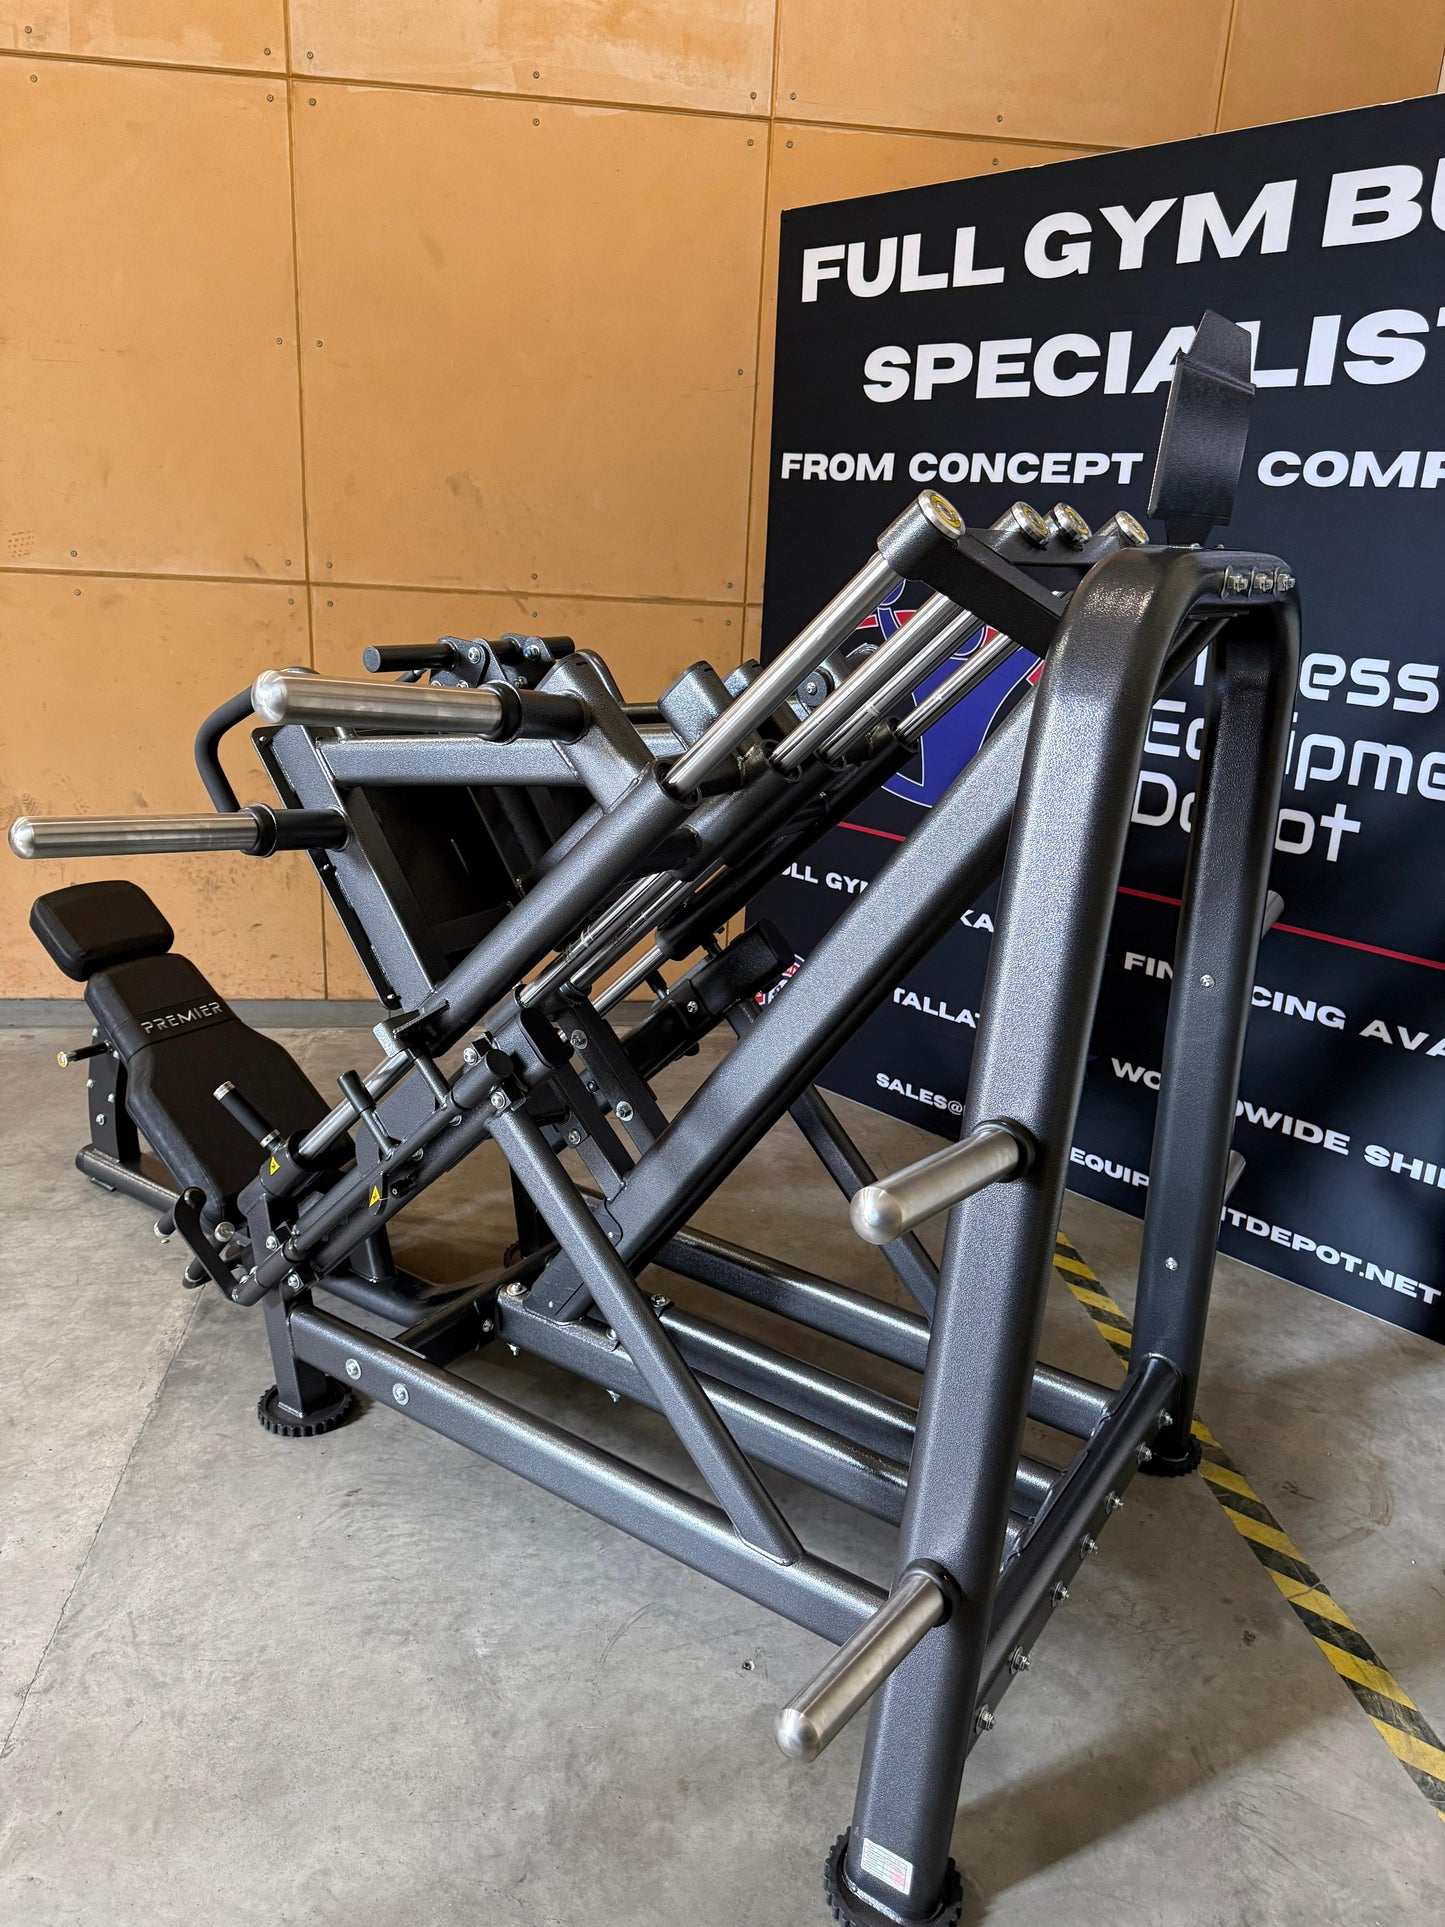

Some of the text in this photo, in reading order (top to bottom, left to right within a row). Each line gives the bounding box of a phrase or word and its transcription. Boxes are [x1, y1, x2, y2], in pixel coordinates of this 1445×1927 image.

[802, 157, 1445, 303] FULL GYM B
[863, 307, 1445, 403] SPECIALIS
[781, 452, 894, 482] FROM
[908, 452, 1144, 485] CONCEPT
[140, 1001, 223, 1034] PREMIER
